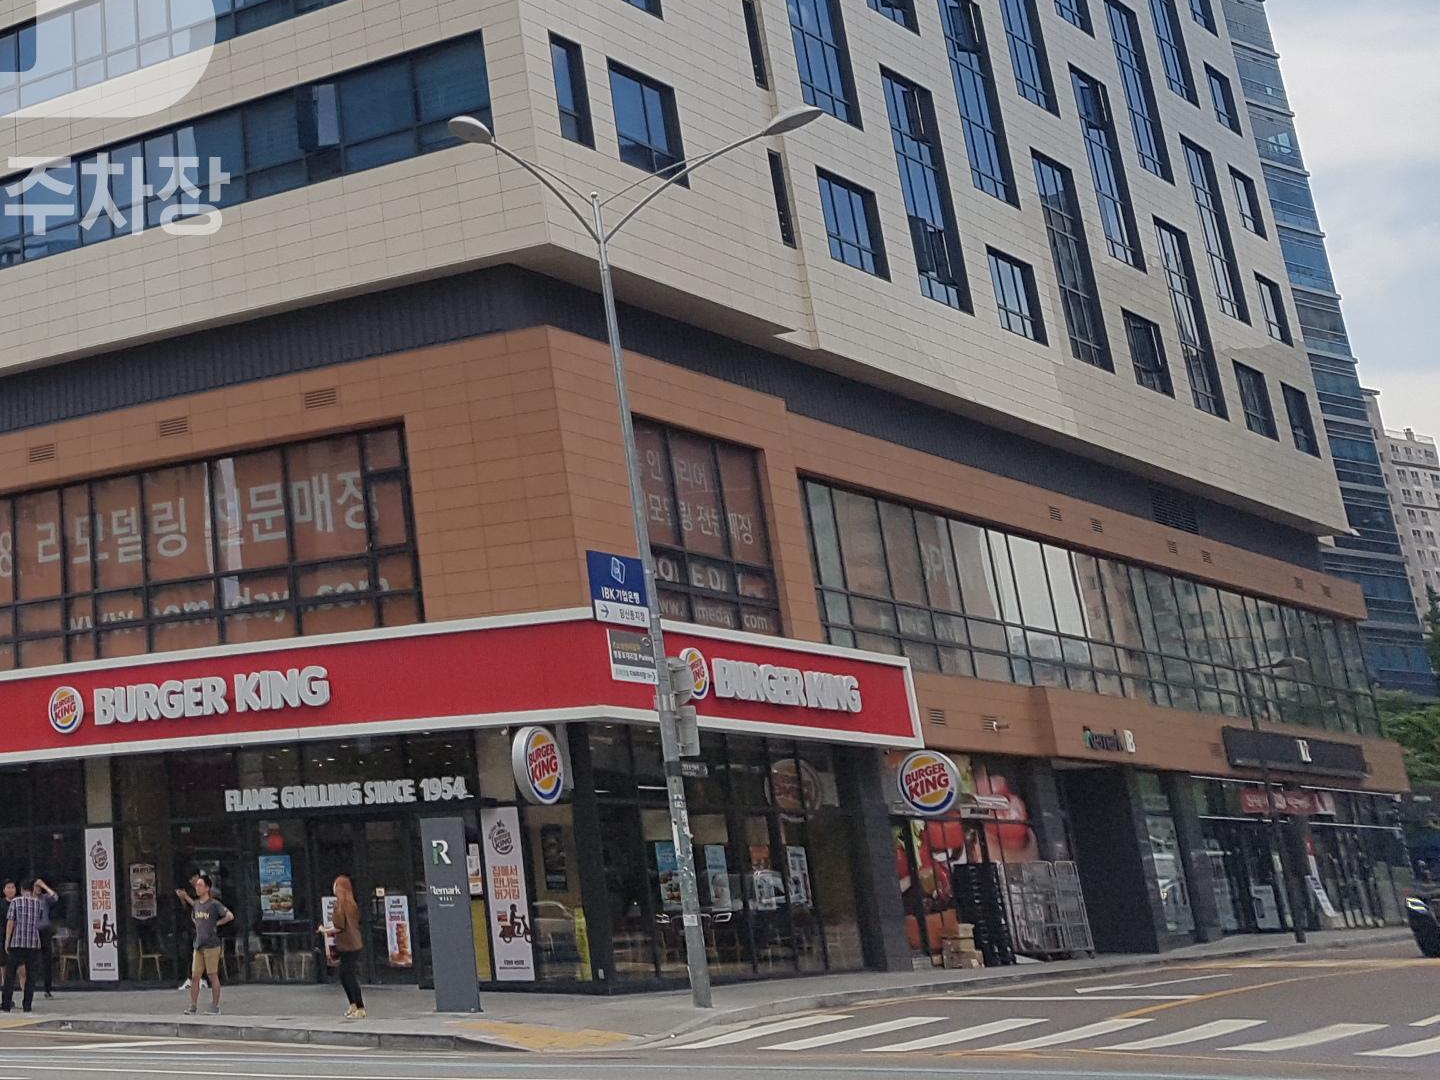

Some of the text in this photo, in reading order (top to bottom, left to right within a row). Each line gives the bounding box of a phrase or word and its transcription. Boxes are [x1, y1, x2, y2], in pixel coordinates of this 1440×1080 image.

[37, 497, 188, 564] 리모델링
[601, 586, 641, 605] IBK 기업은행
[93, 665, 331, 726] BURGER KING
[711, 658, 862, 713] BURGER KING
[54, 702, 76, 723] KING
[528, 743, 556, 767] BURGER
[530, 755, 559, 783] KING
[905, 763, 946, 786] BURGER
[224, 775, 469, 812] FLAME GRILLING SINCE 1954
[909, 773, 950, 801] KING
[432, 840, 452, 865] R
[491, 865, 517, 876] 집에서
[493, 877, 519, 888] 만나는
[430, 884, 461, 895] Remark
